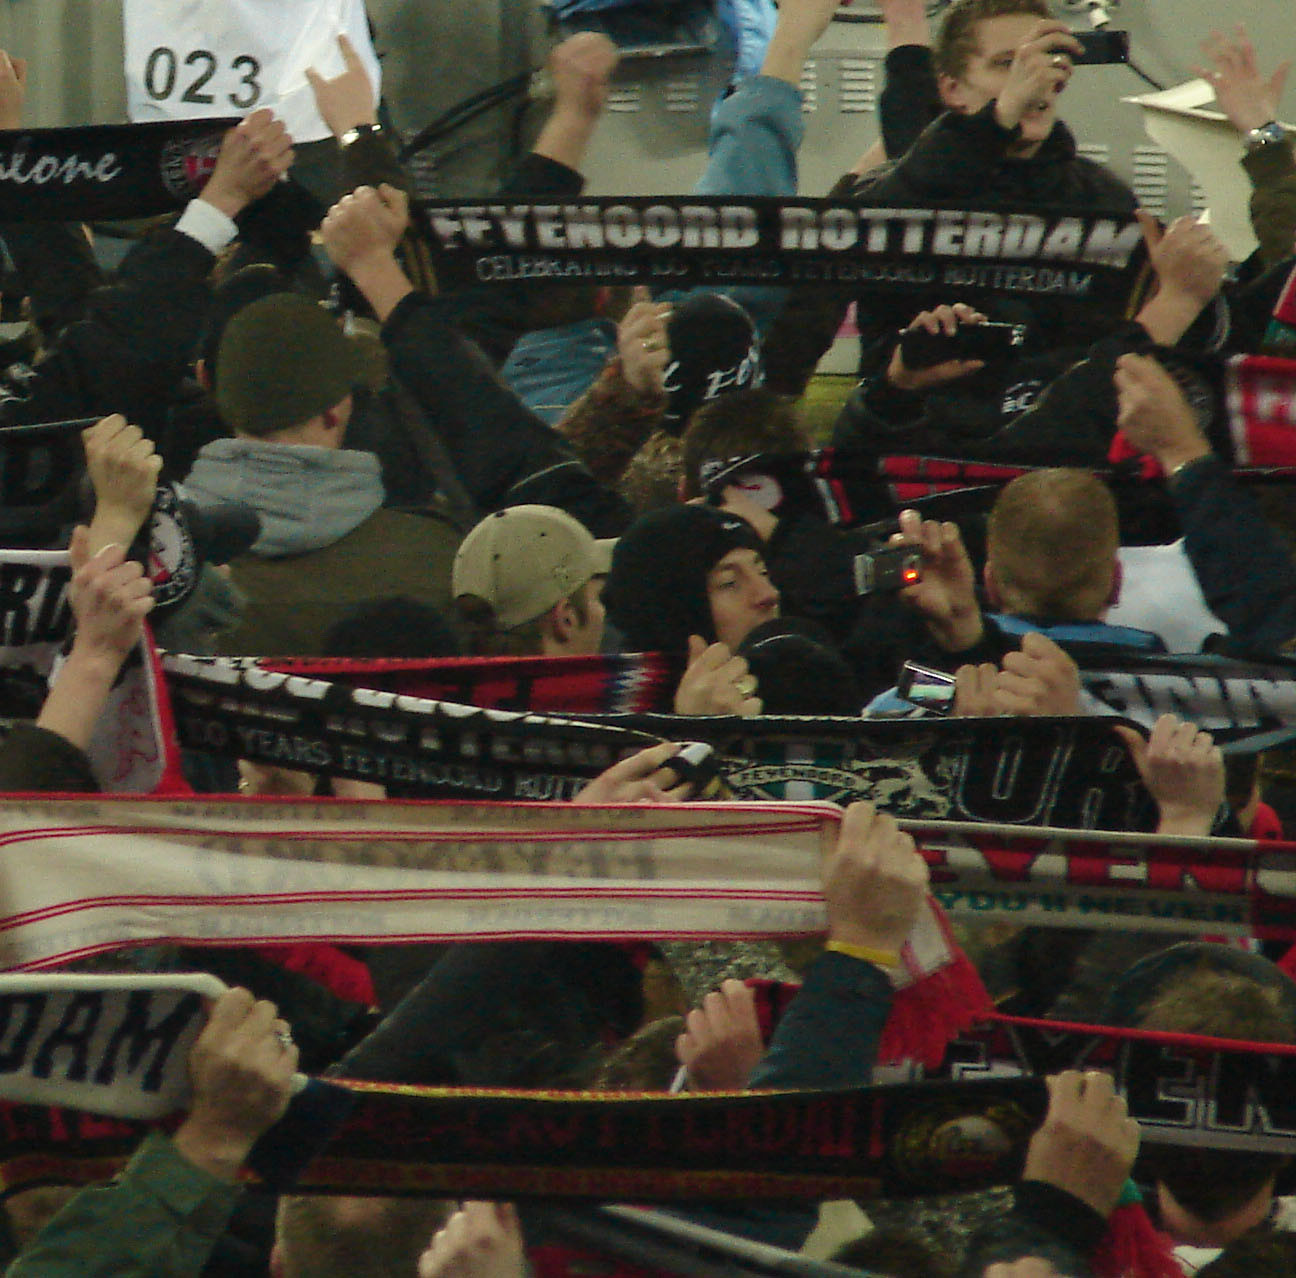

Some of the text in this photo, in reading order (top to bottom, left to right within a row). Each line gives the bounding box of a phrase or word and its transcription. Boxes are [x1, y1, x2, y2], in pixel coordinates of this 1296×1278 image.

[144, 47, 262, 109] 023
[428, 204, 1145, 270] FEYENOORD ROTTERDAM
[943, 263, 1096, 295] ROTTERDAM
